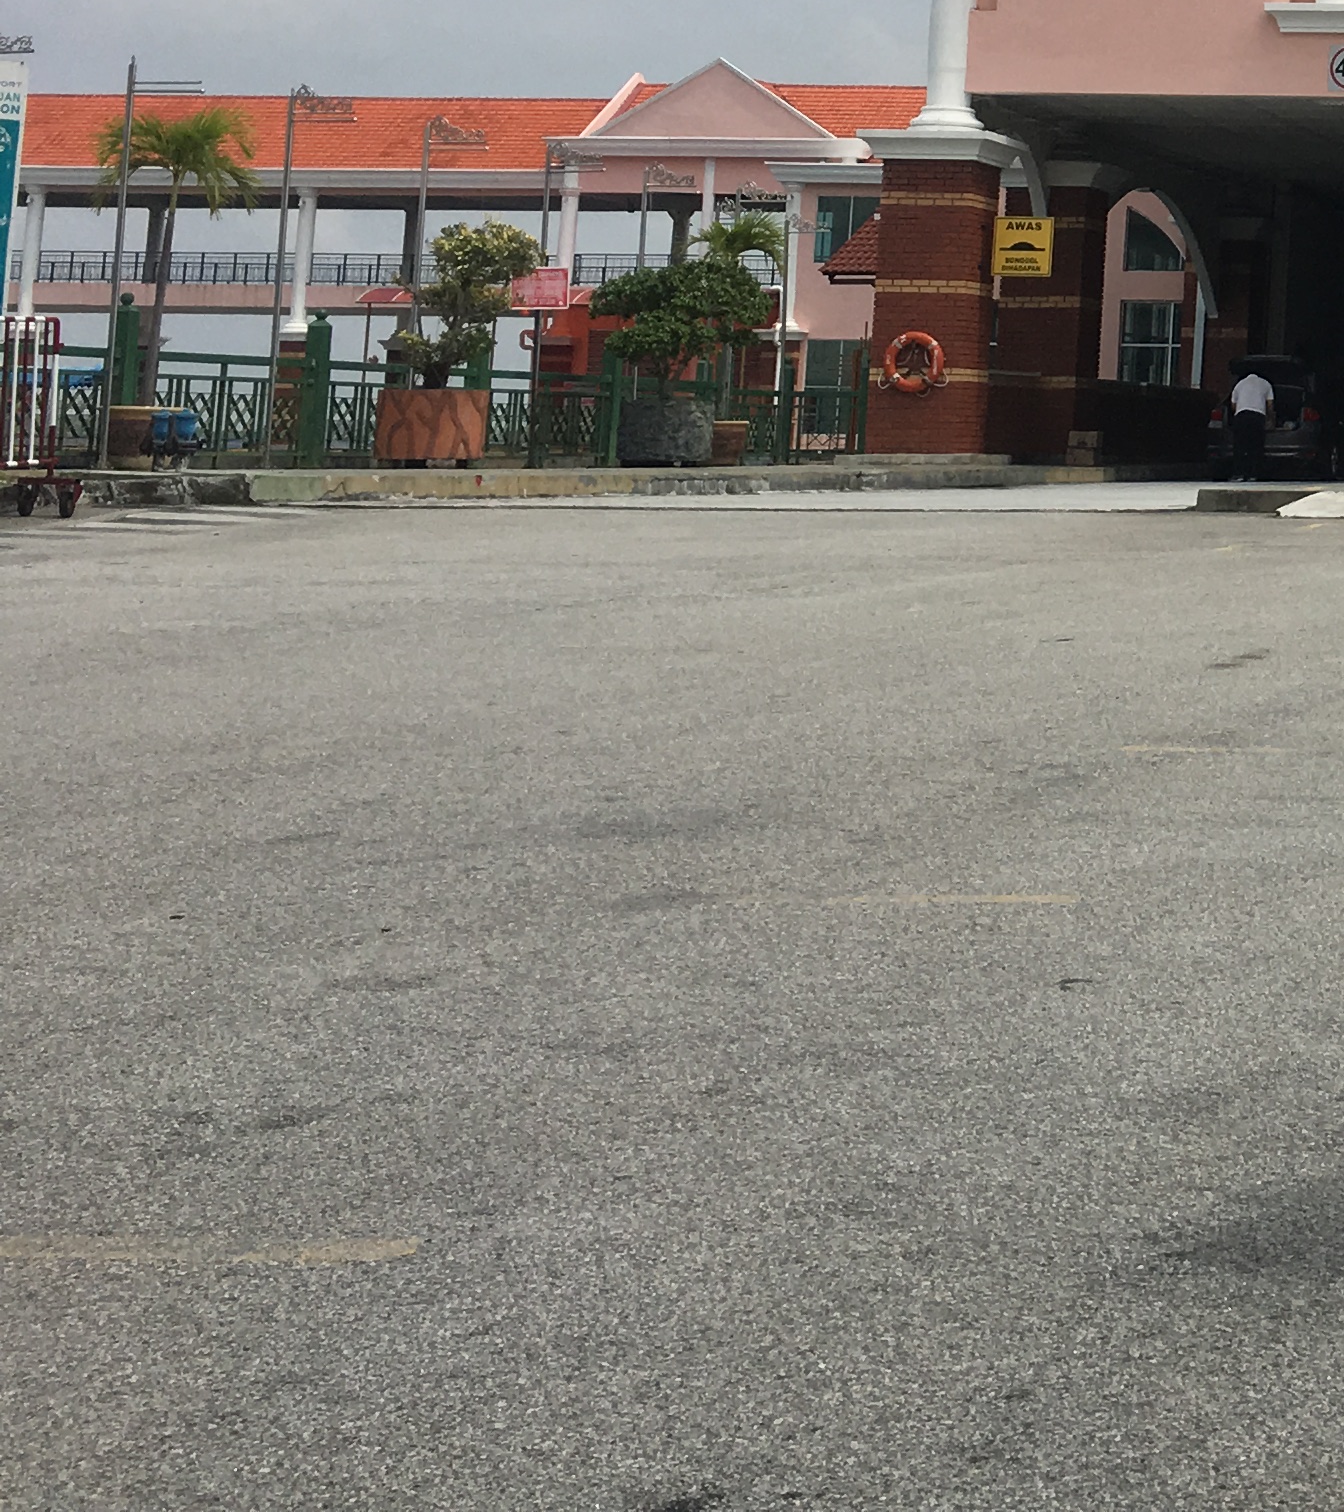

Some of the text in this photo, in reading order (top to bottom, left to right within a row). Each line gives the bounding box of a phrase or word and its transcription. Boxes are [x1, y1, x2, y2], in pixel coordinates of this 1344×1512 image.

[0, 80, 22, 88] ORT
[0, 104, 20, 114] ON
[1005, 221, 1042, 231] AWAS
